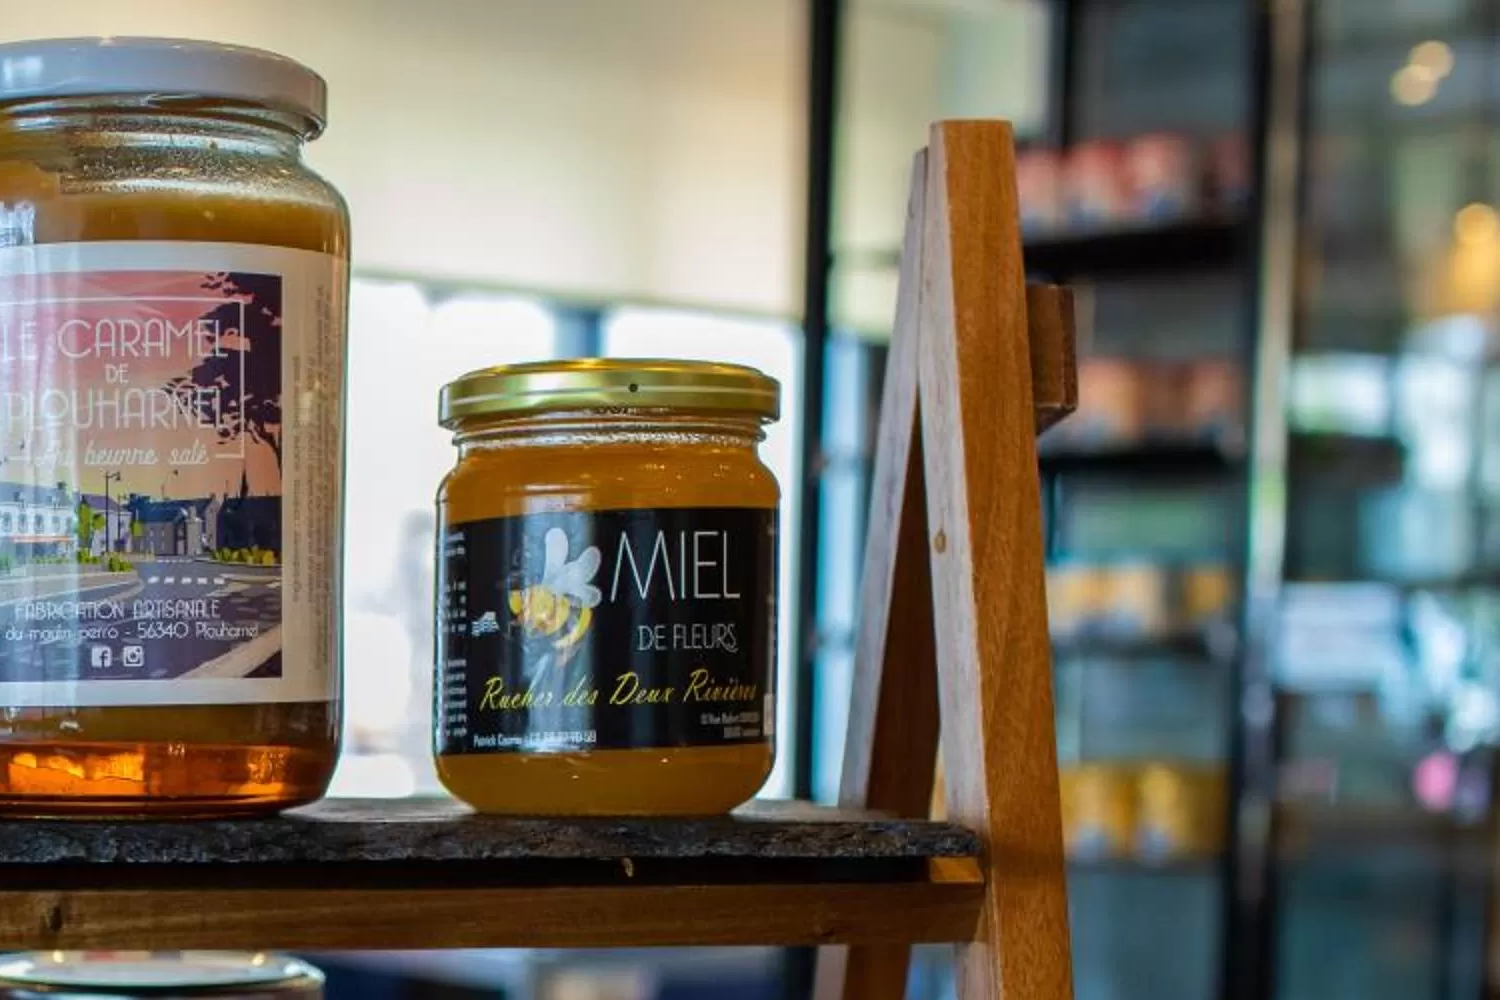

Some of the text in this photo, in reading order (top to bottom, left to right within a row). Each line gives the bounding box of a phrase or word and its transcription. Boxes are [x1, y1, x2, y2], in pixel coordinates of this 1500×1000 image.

[2, 318, 229, 361] LE CARAMEL
[104, 363, 130, 385] DE
[6, 387, 227, 432] PLOUHARNEL
[610, 530, 741, 603] MIEL
[14, 599, 221, 620] FABRICATION ARTISANALE
[137, 621, 189, 639] 56340
[638, 624, 739, 652] DE FLEURS
[610, 671, 674, 705] Deux
